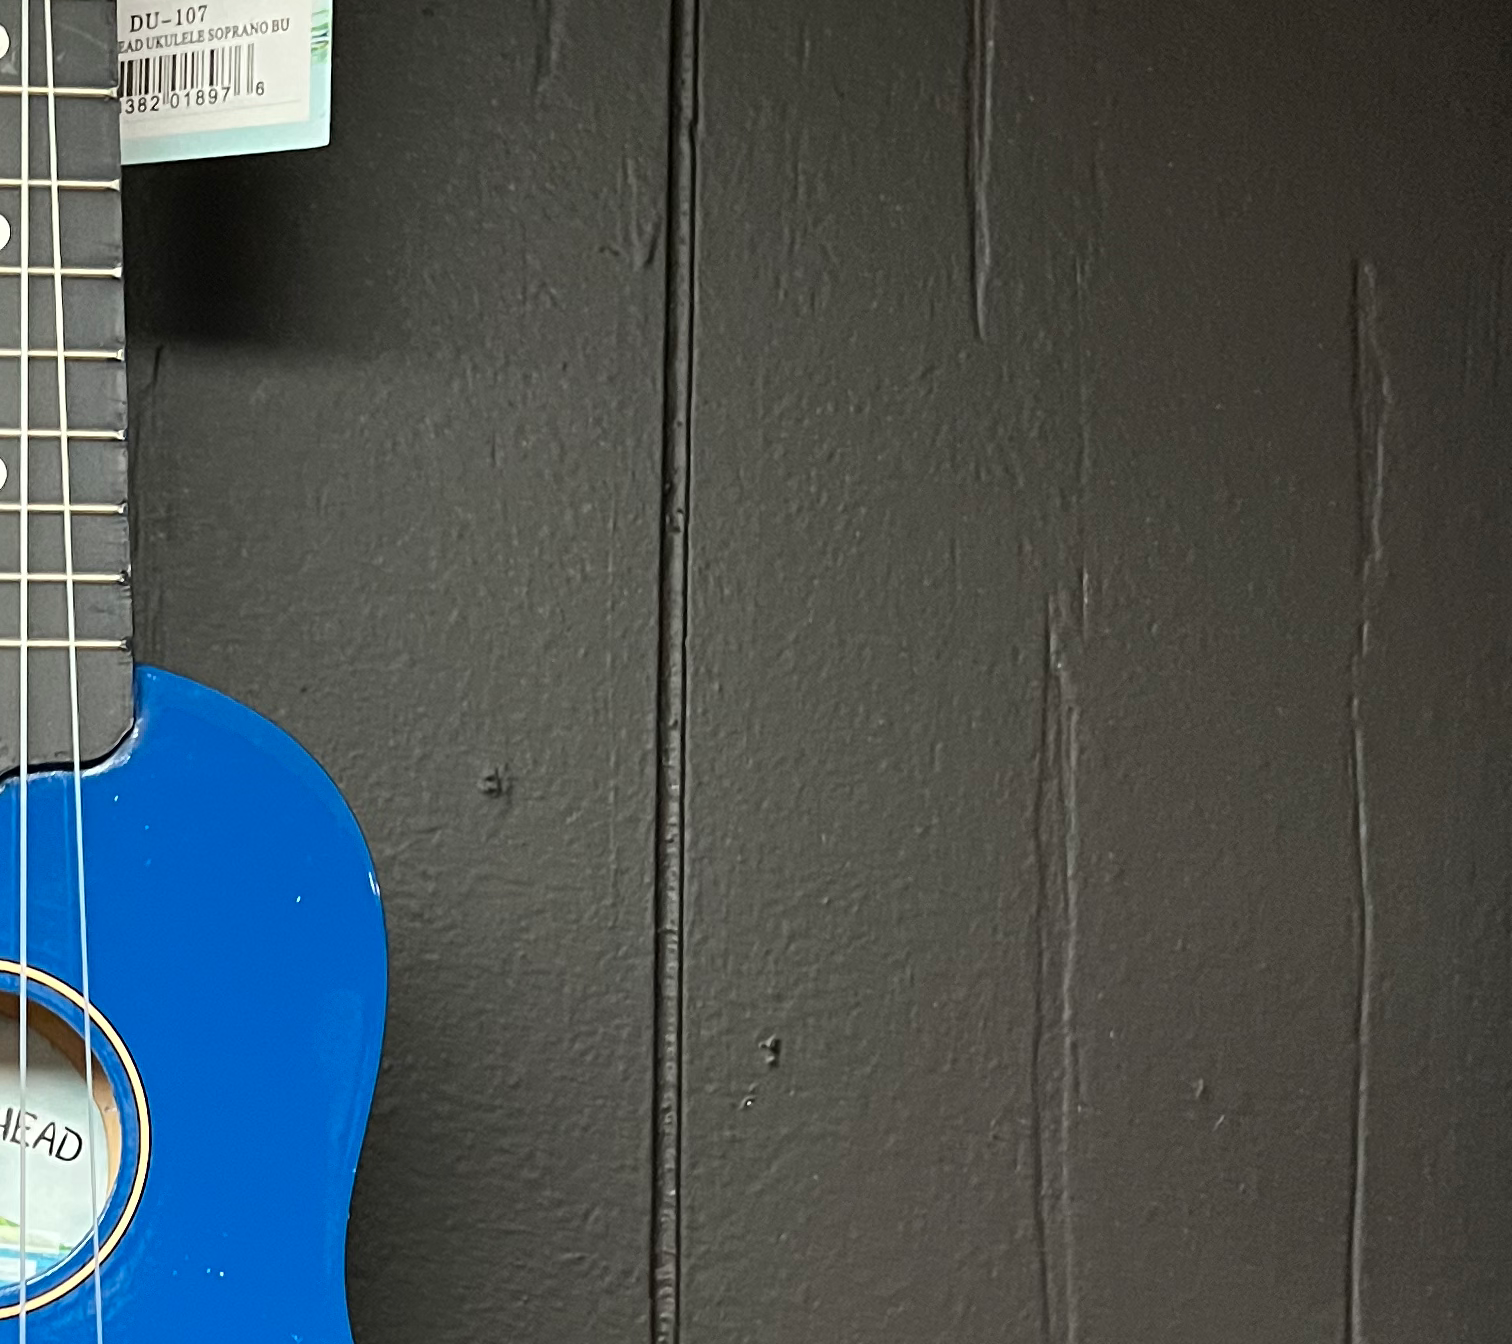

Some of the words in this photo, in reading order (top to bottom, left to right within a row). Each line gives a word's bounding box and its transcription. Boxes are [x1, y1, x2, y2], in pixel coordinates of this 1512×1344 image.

[130, 5, 207, 33] DU-107
[118, 39, 143, 54] EAD
[146, 30, 204, 50] UKULELE
[208, 21, 268, 41] SOPRANO
[271, 17, 290, 33] BU
[170, 86, 230, 109] 01897
[255, 81, 265, 96] 6
